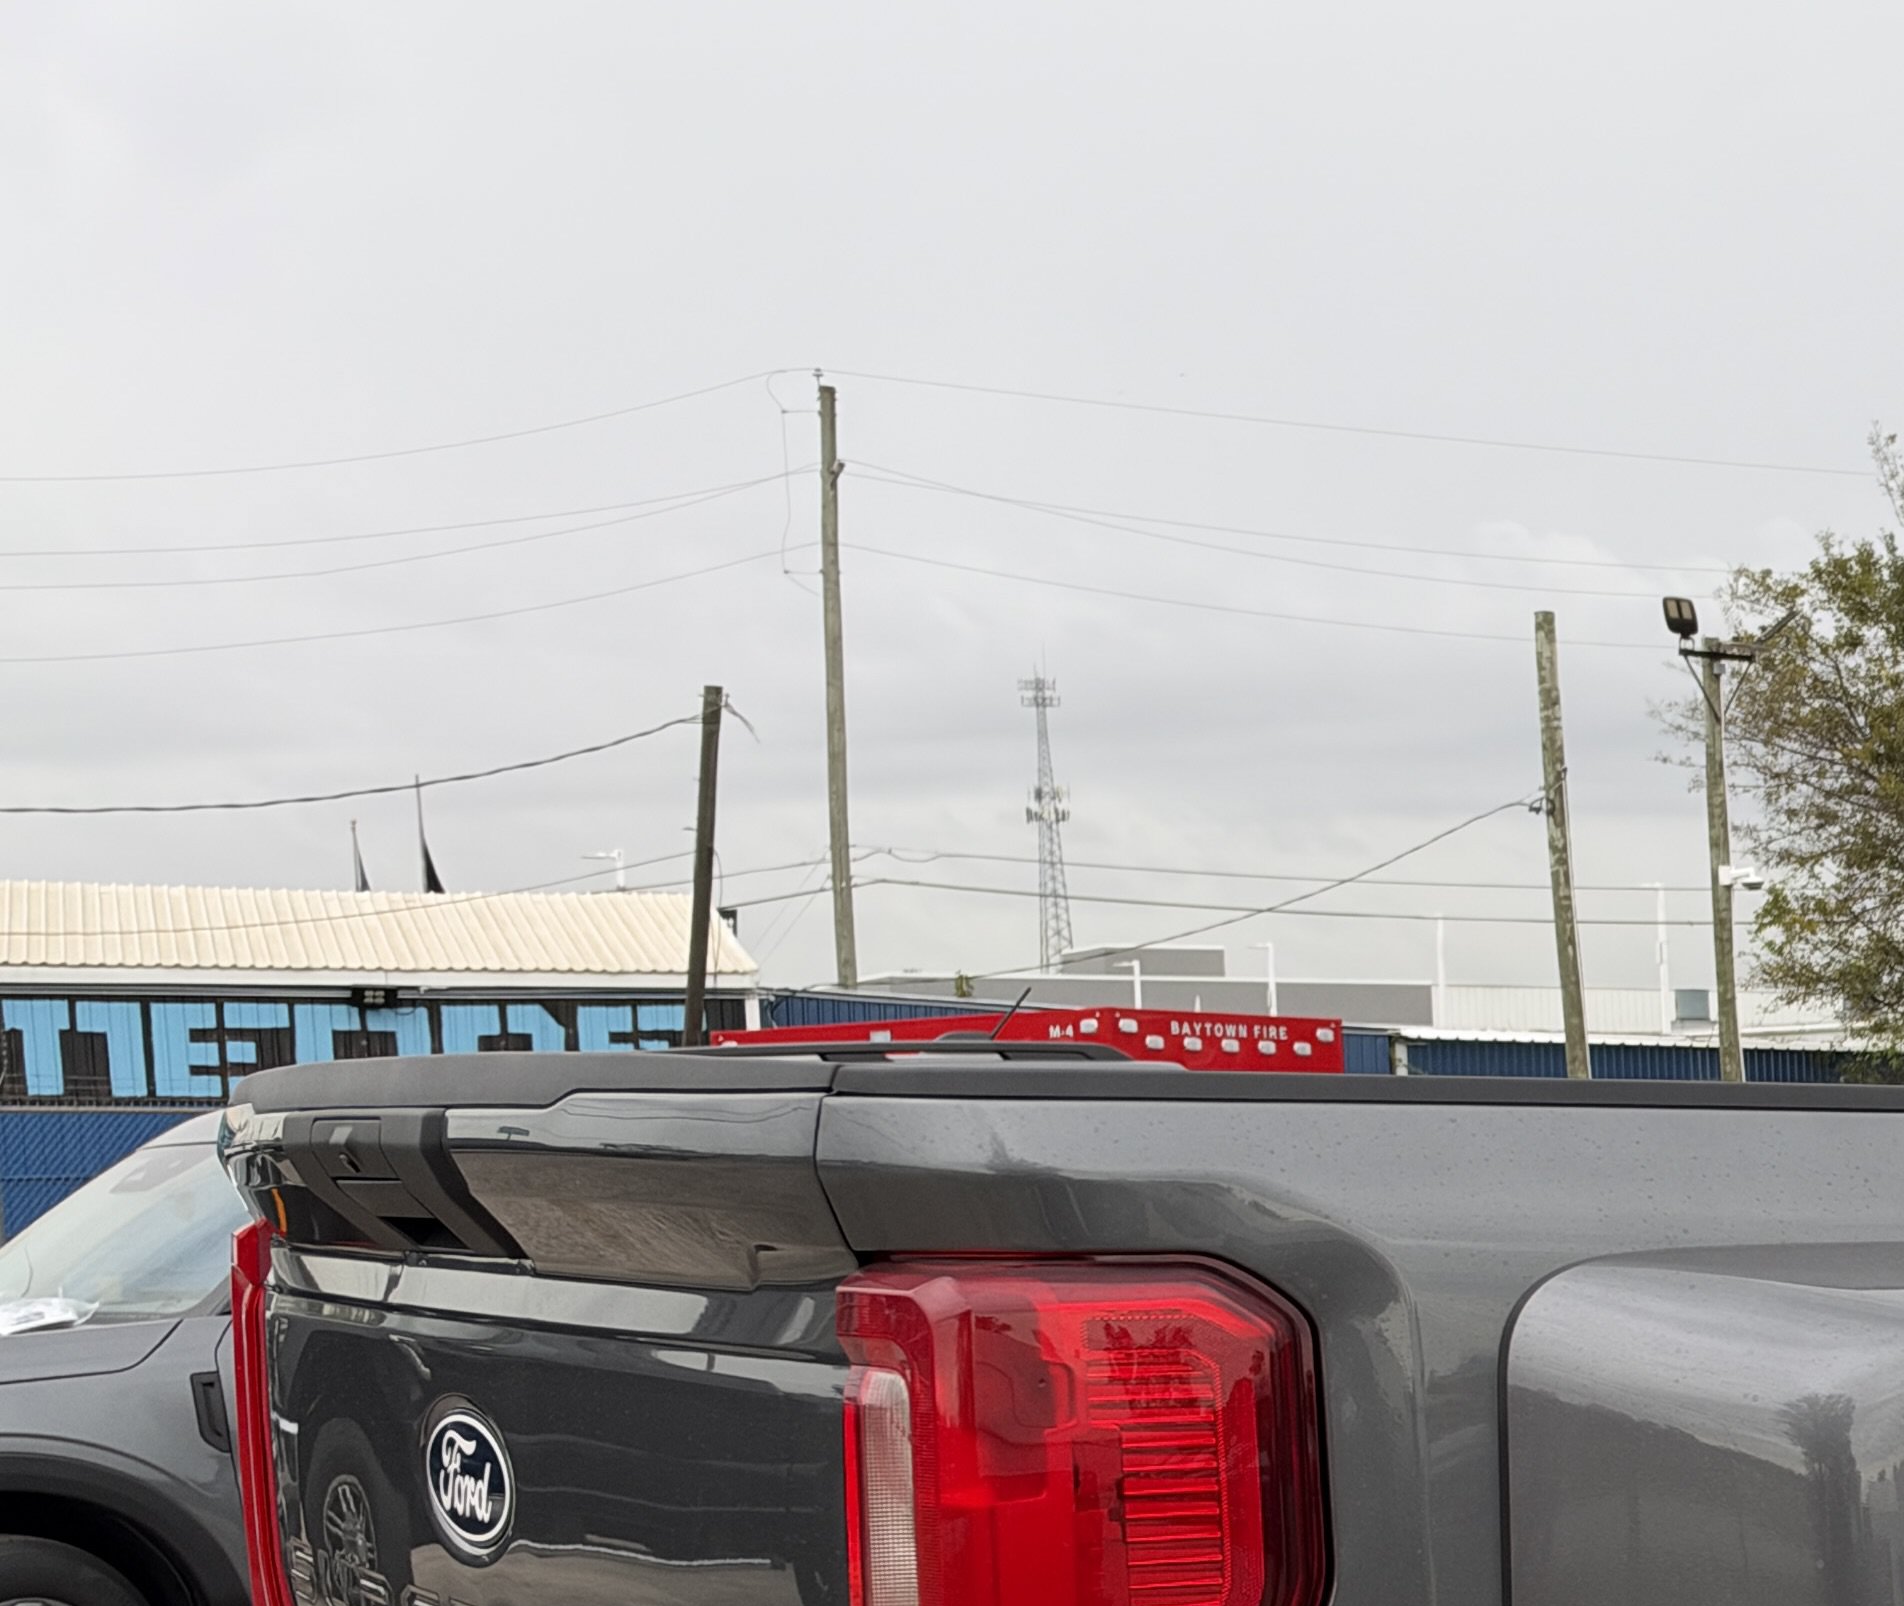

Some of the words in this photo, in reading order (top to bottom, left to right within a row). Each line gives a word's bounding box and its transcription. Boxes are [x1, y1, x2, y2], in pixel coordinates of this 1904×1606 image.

[1169, 1020, 1248, 1039] BAYTOWN
[1253, 1024, 1288, 1041] FIRE
[440, 1429, 493, 1525] Ford
